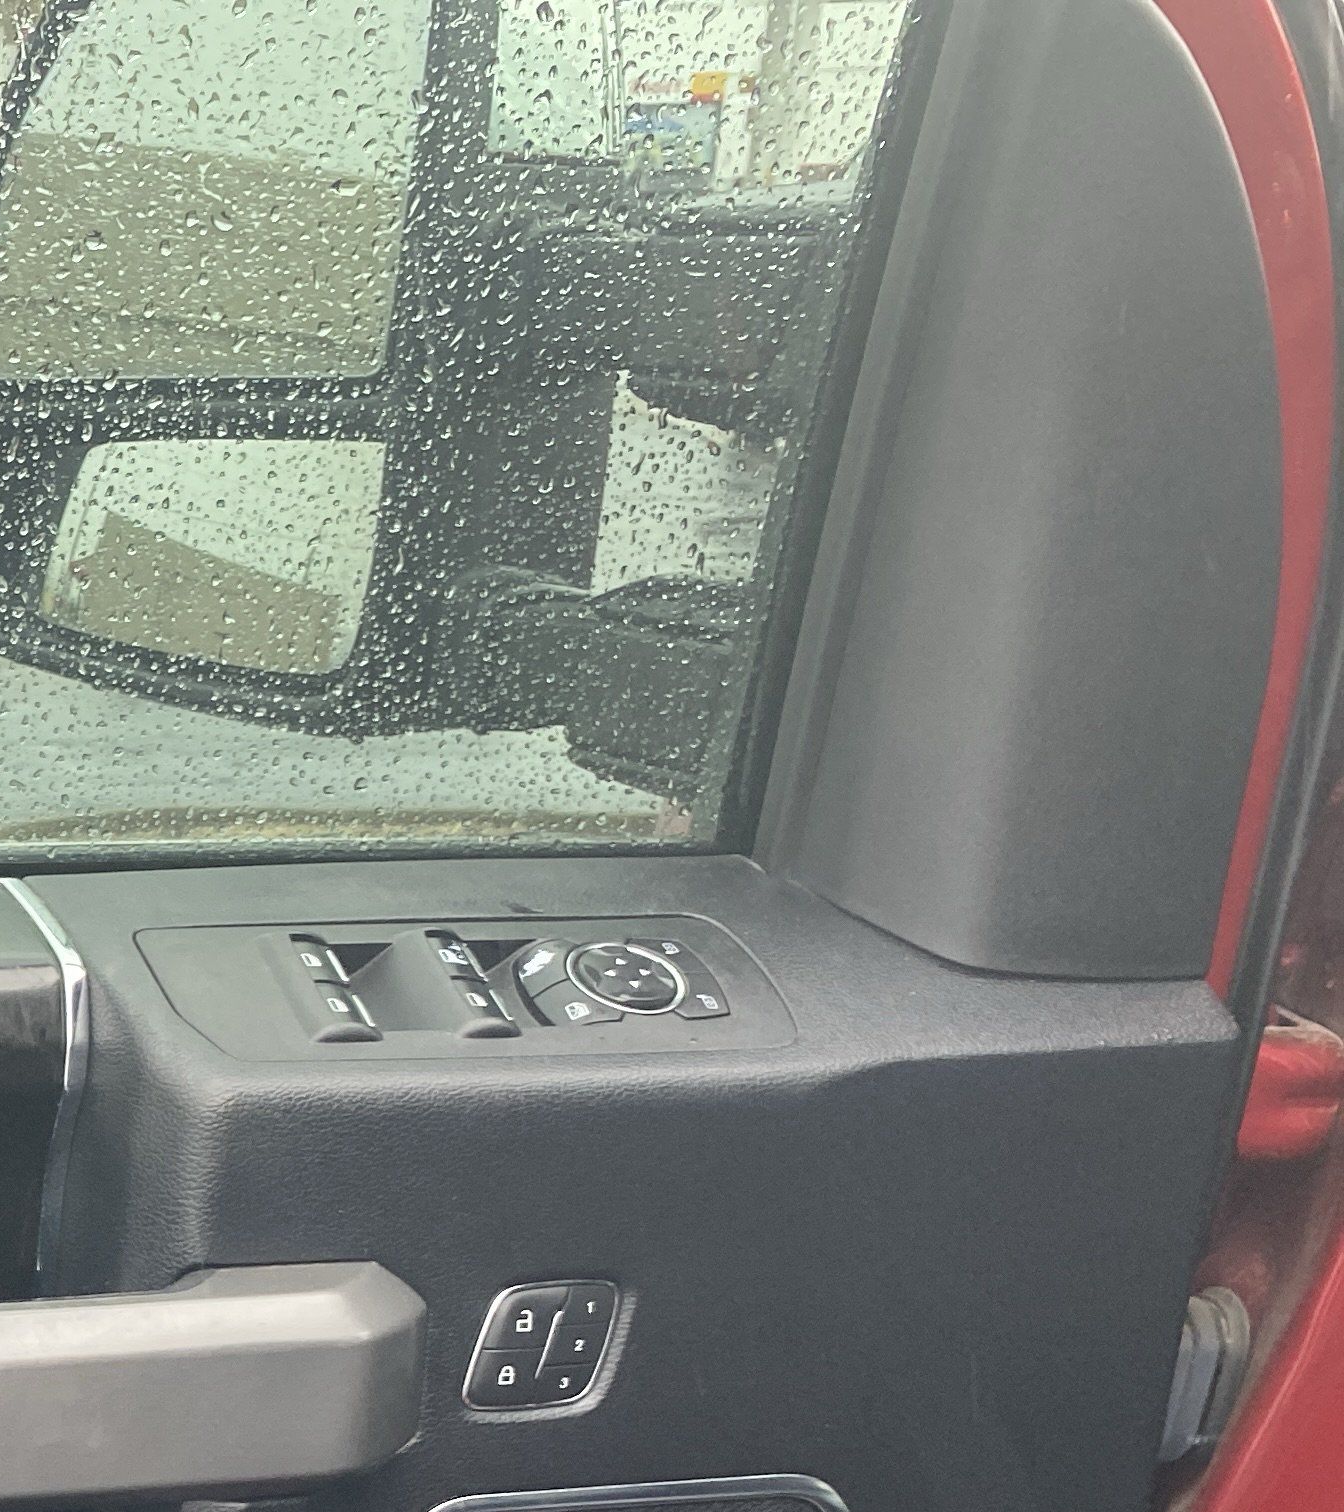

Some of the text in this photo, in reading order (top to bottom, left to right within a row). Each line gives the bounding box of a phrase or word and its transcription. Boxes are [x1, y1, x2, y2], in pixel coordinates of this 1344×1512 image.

[586, 1302, 595, 1314] 1
[574, 1339, 585, 1352] 2
[558, 1377, 570, 1389] 3
